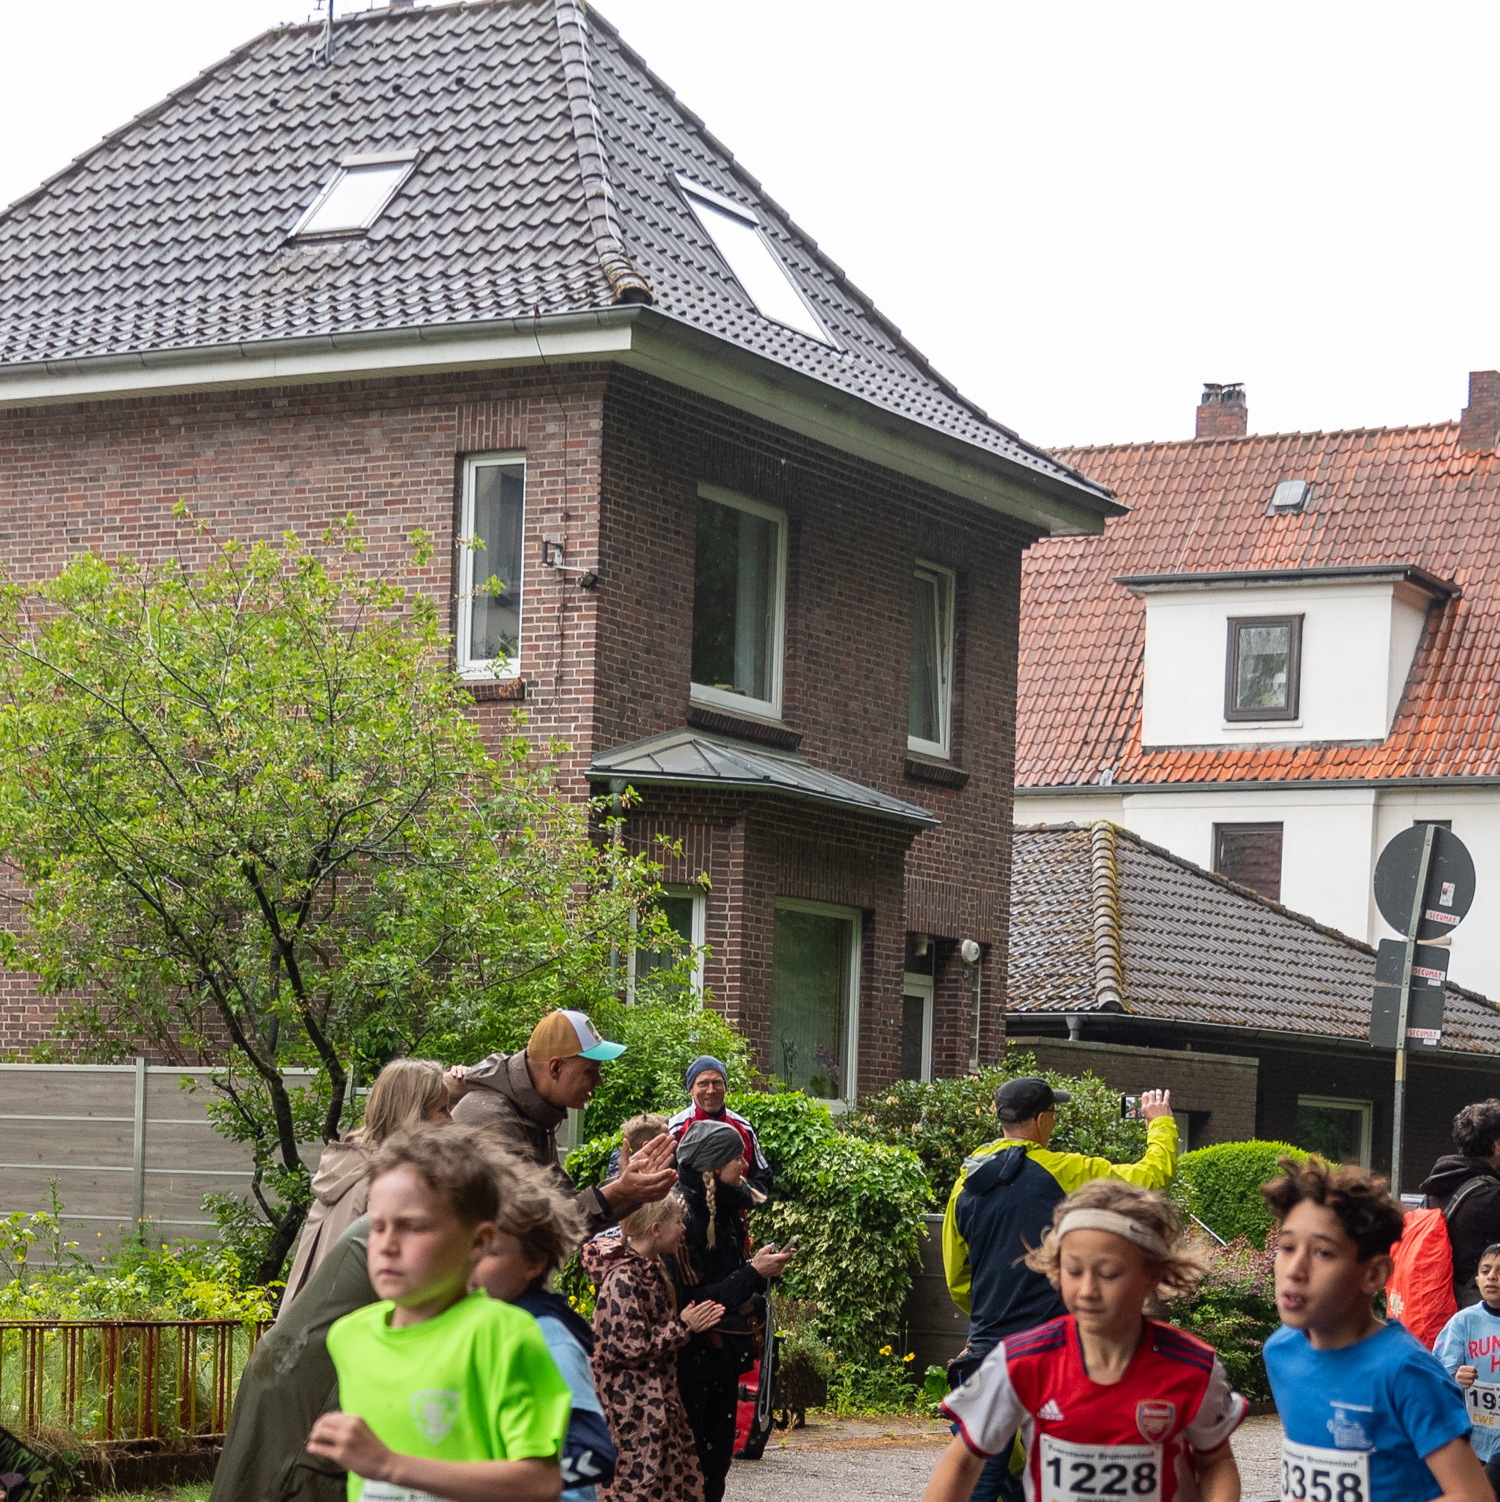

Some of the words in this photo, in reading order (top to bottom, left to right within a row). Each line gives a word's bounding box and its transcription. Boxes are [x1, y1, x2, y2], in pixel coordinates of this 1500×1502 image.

[1429, 911, 1457, 924] SECUMAT
[1413, 967, 1442, 978] SECUMAT
[1408, 1029, 1437, 1038] SECUMAT
[1472, 1413, 1495, 1426] EWE
[1046, 1457, 1157, 1496] 1228
